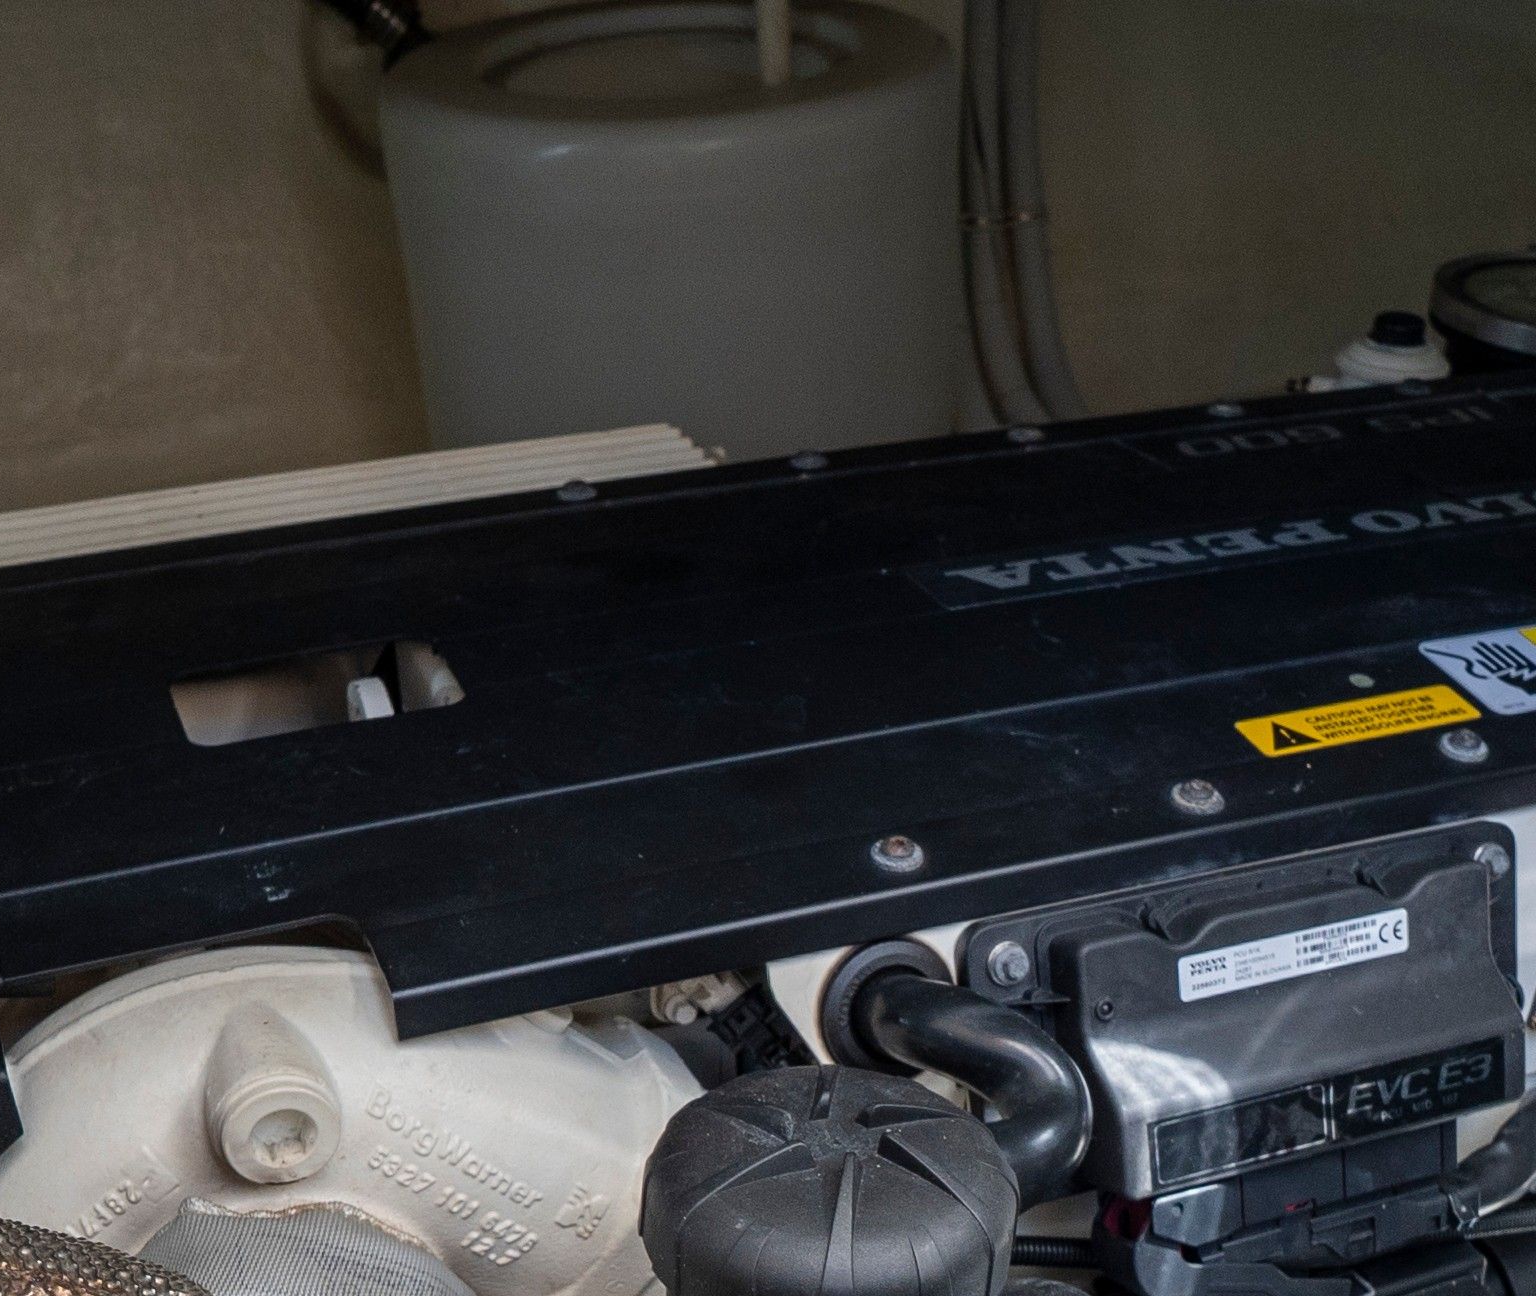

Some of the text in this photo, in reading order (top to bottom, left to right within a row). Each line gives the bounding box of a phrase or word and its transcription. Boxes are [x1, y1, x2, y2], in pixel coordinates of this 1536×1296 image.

[1176, 406, 1496, 458] IPS 600
[947, 518, 1349, 590] PENTA
[1190, 956, 1226, 969] VOLVO
[1190, 964, 1228, 976] PENTA
[1346, 1053, 1492, 1115] EVC E3
[366, 1087, 544, 1210] BorgWarner
[367, 1143, 436, 1194] 5327
